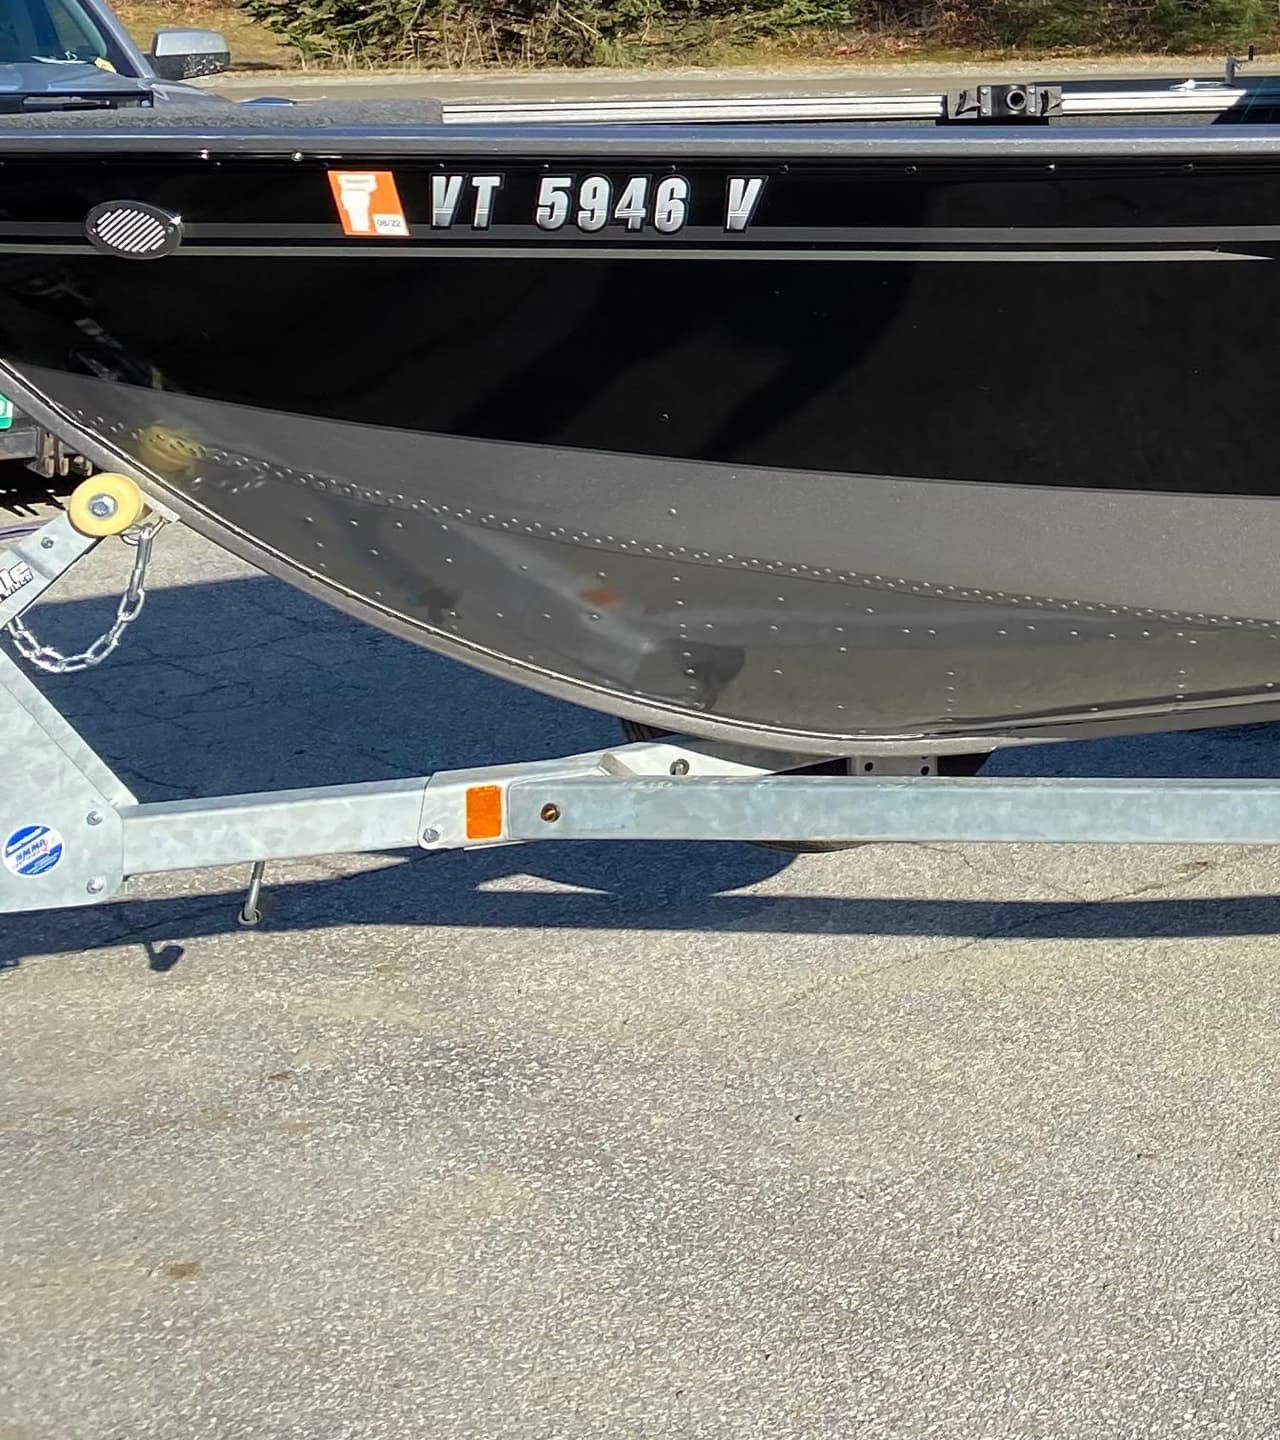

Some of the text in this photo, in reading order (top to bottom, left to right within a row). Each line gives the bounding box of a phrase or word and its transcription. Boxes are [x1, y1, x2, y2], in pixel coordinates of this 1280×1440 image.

[430, 175, 764, 232] VT 5946 V
